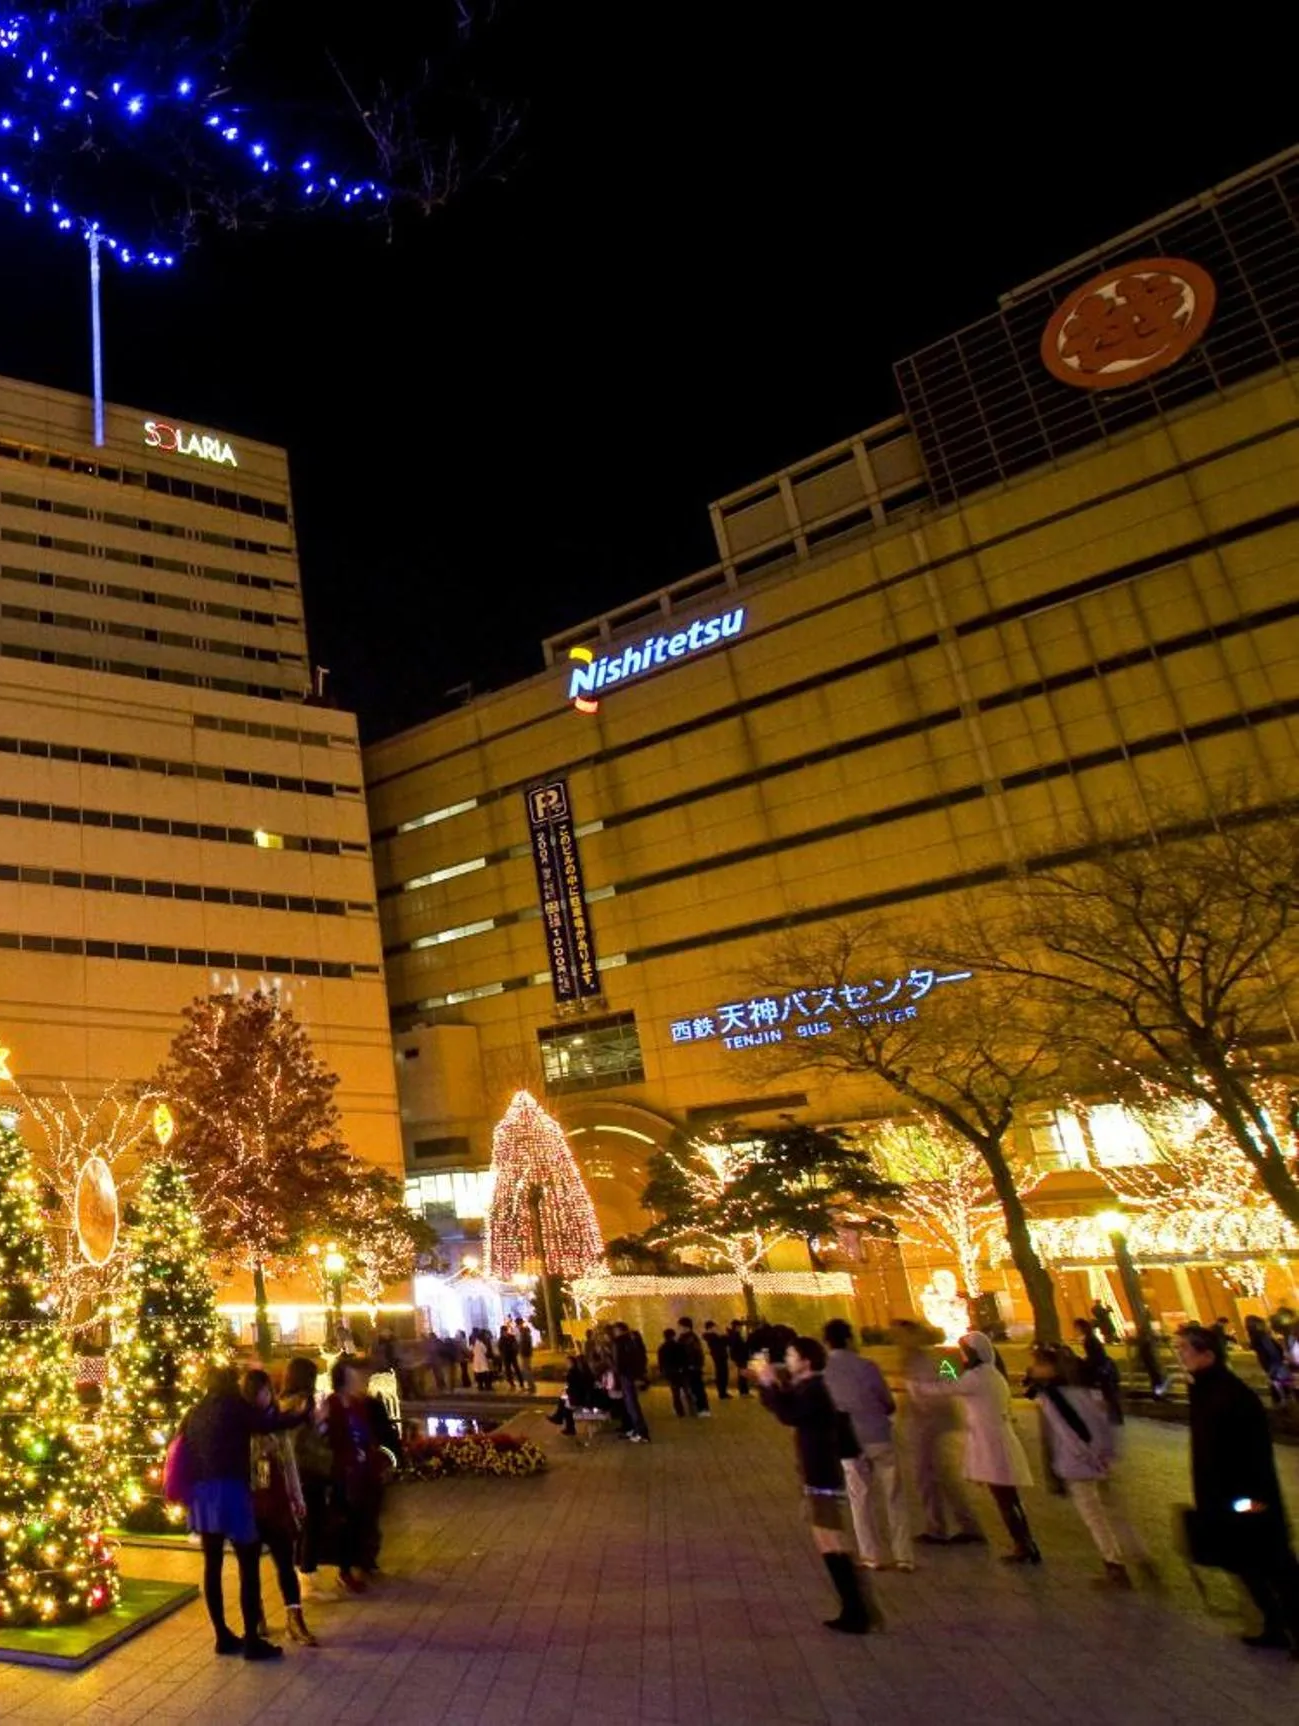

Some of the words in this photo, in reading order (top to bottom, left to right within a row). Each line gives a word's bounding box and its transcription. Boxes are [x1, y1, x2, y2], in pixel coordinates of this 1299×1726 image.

[143, 421, 238, 467] SOLARIA
[568, 607, 745, 707] Nishitetsu
[723, 1029, 782, 1050] TENJIN
[796, 1021, 832, 1038] BUS
